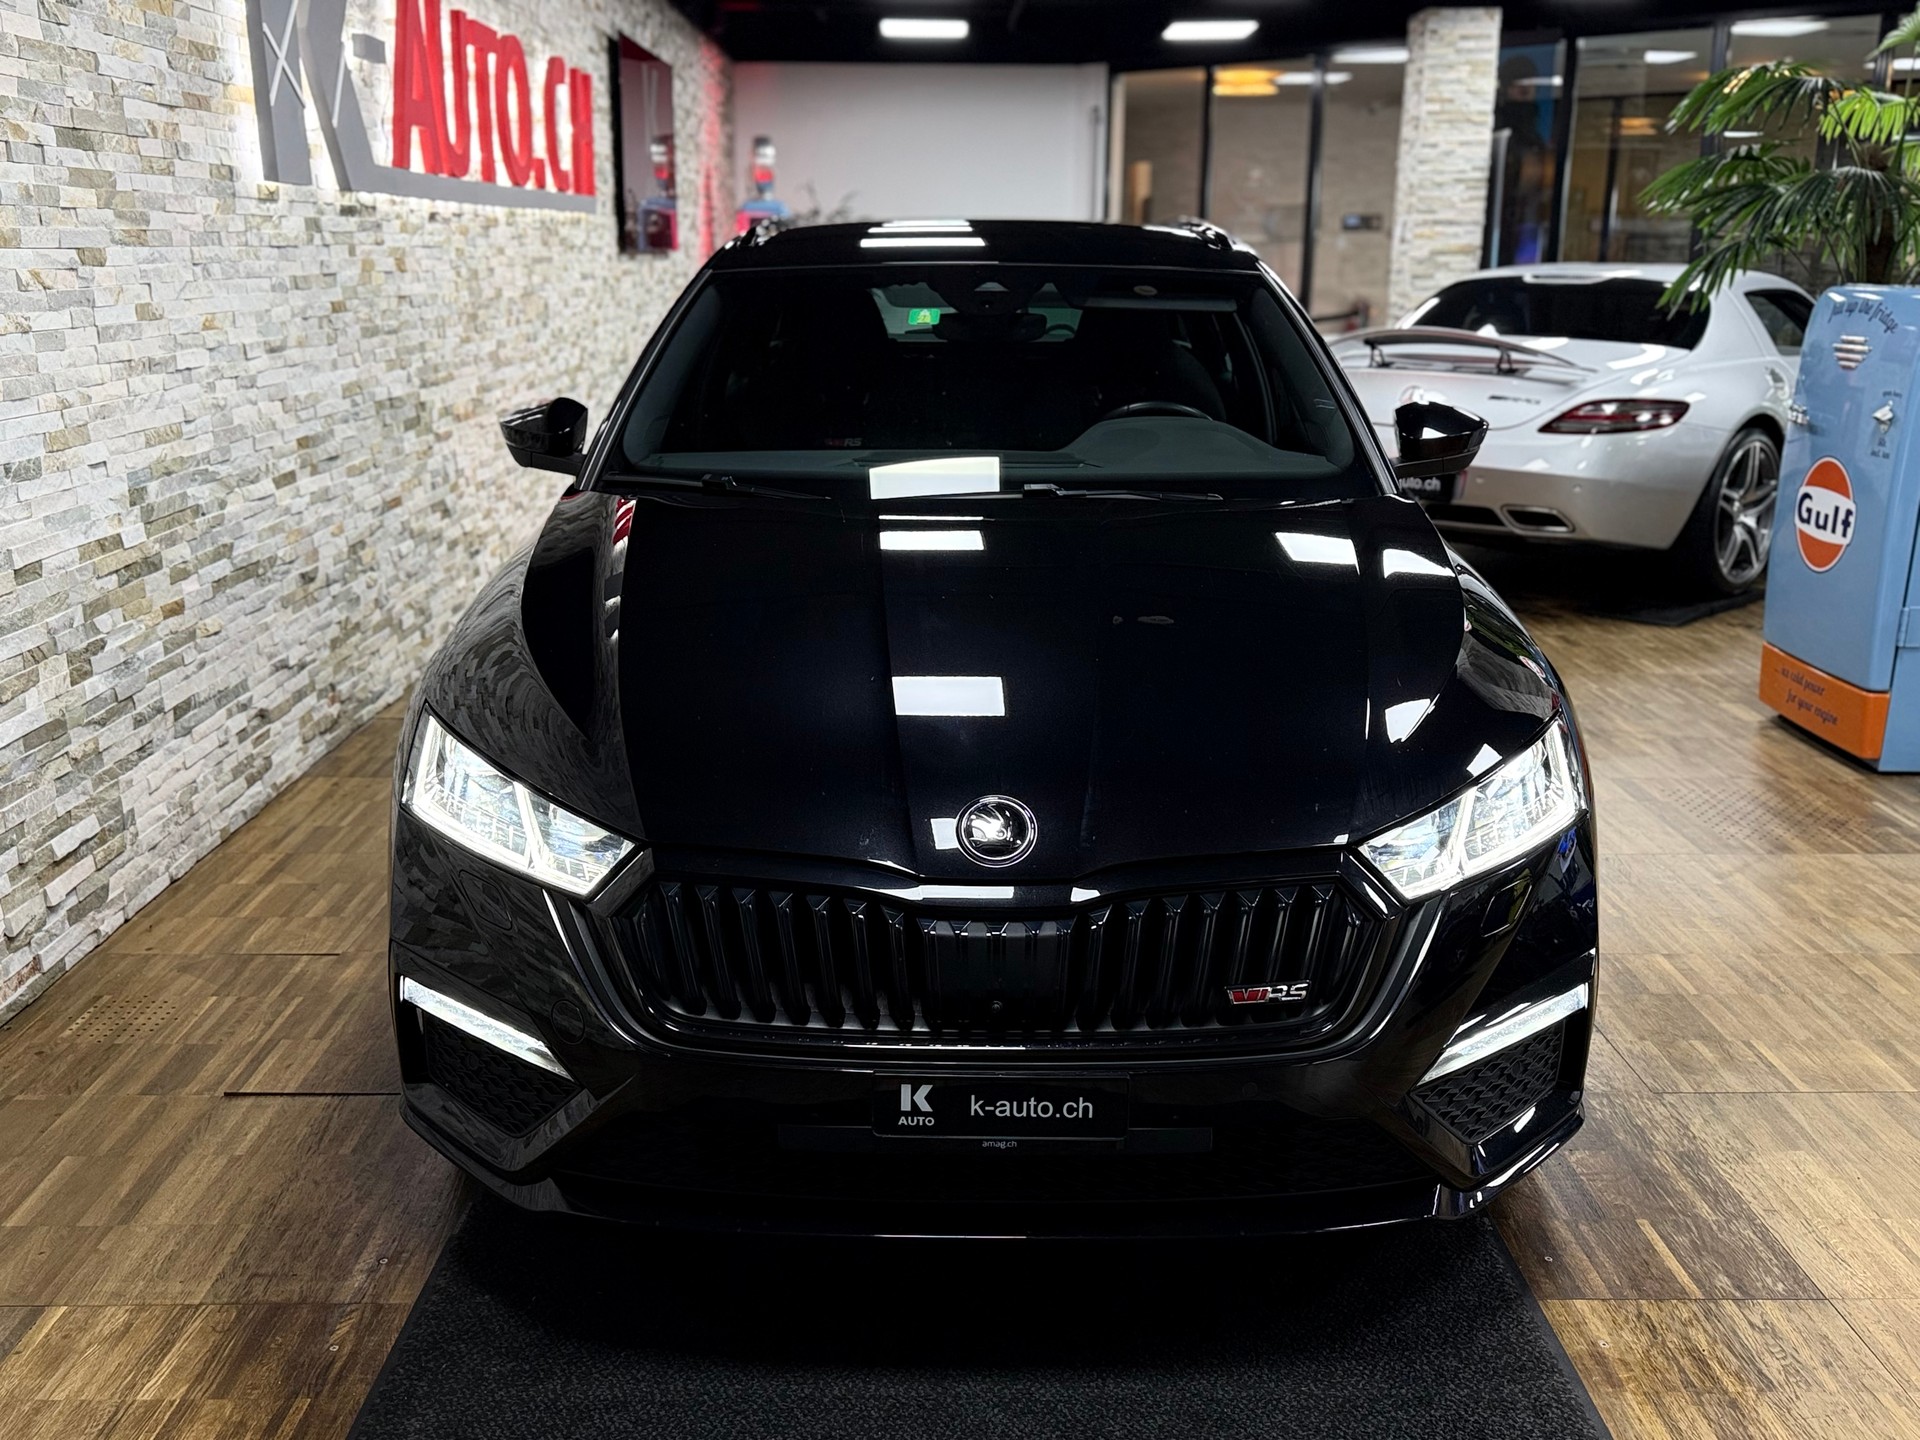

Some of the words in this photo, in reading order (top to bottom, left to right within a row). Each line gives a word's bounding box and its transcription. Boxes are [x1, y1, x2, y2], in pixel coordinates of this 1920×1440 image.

[1867, 302, 1898, 334] fridge
[1797, 491, 1853, 539] Gulf
[900, 1083, 934, 1113] K
[970, 1094, 1094, 1119] k-auto.ch
[898, 1116, 935, 1127] AUTO
[981, 1140, 1018, 1149] amag.ch
